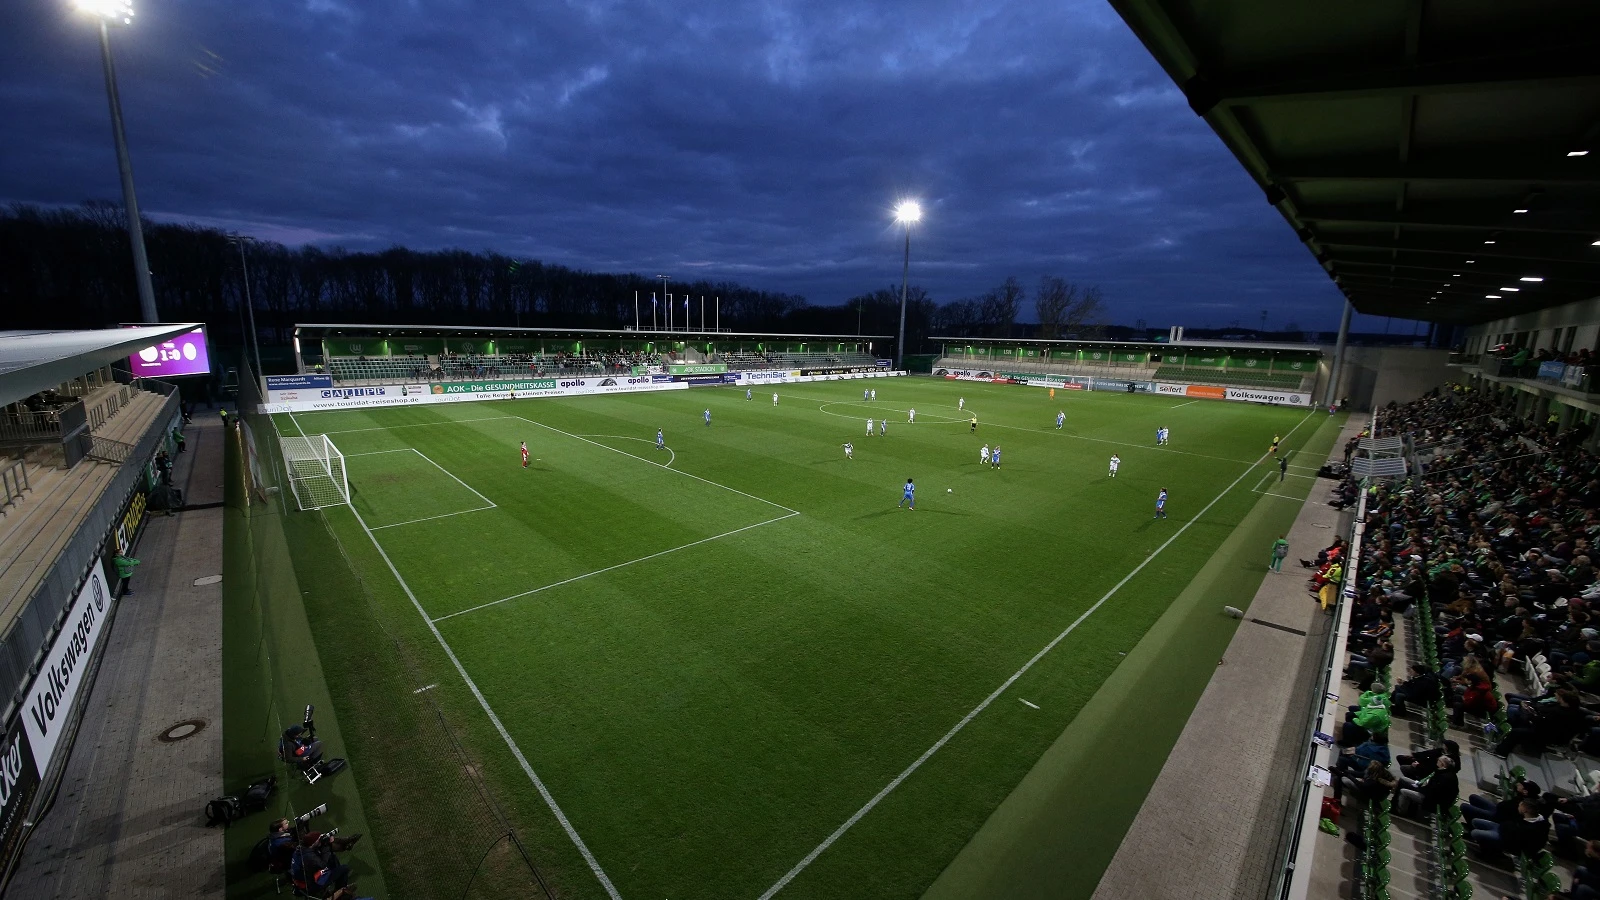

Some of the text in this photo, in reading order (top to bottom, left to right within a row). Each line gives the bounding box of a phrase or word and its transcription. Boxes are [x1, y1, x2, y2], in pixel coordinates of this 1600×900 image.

[160, 349, 181, 361] 1:0
[628, 377, 649, 385] apollo
[746, 372, 786, 380] TechniSat
[447, 385, 465, 393] AOK
[485, 382, 554, 391] GESUNDHEITSKASSE
[560, 379, 585, 388] apollo
[321, 388, 385, 399] GALIPP
[1230, 391, 1285, 402] Volkswagen
[313, 397, 419, 408] www.touridat-reiseshop.de
[31, 602, 96, 738] Volkswagen
